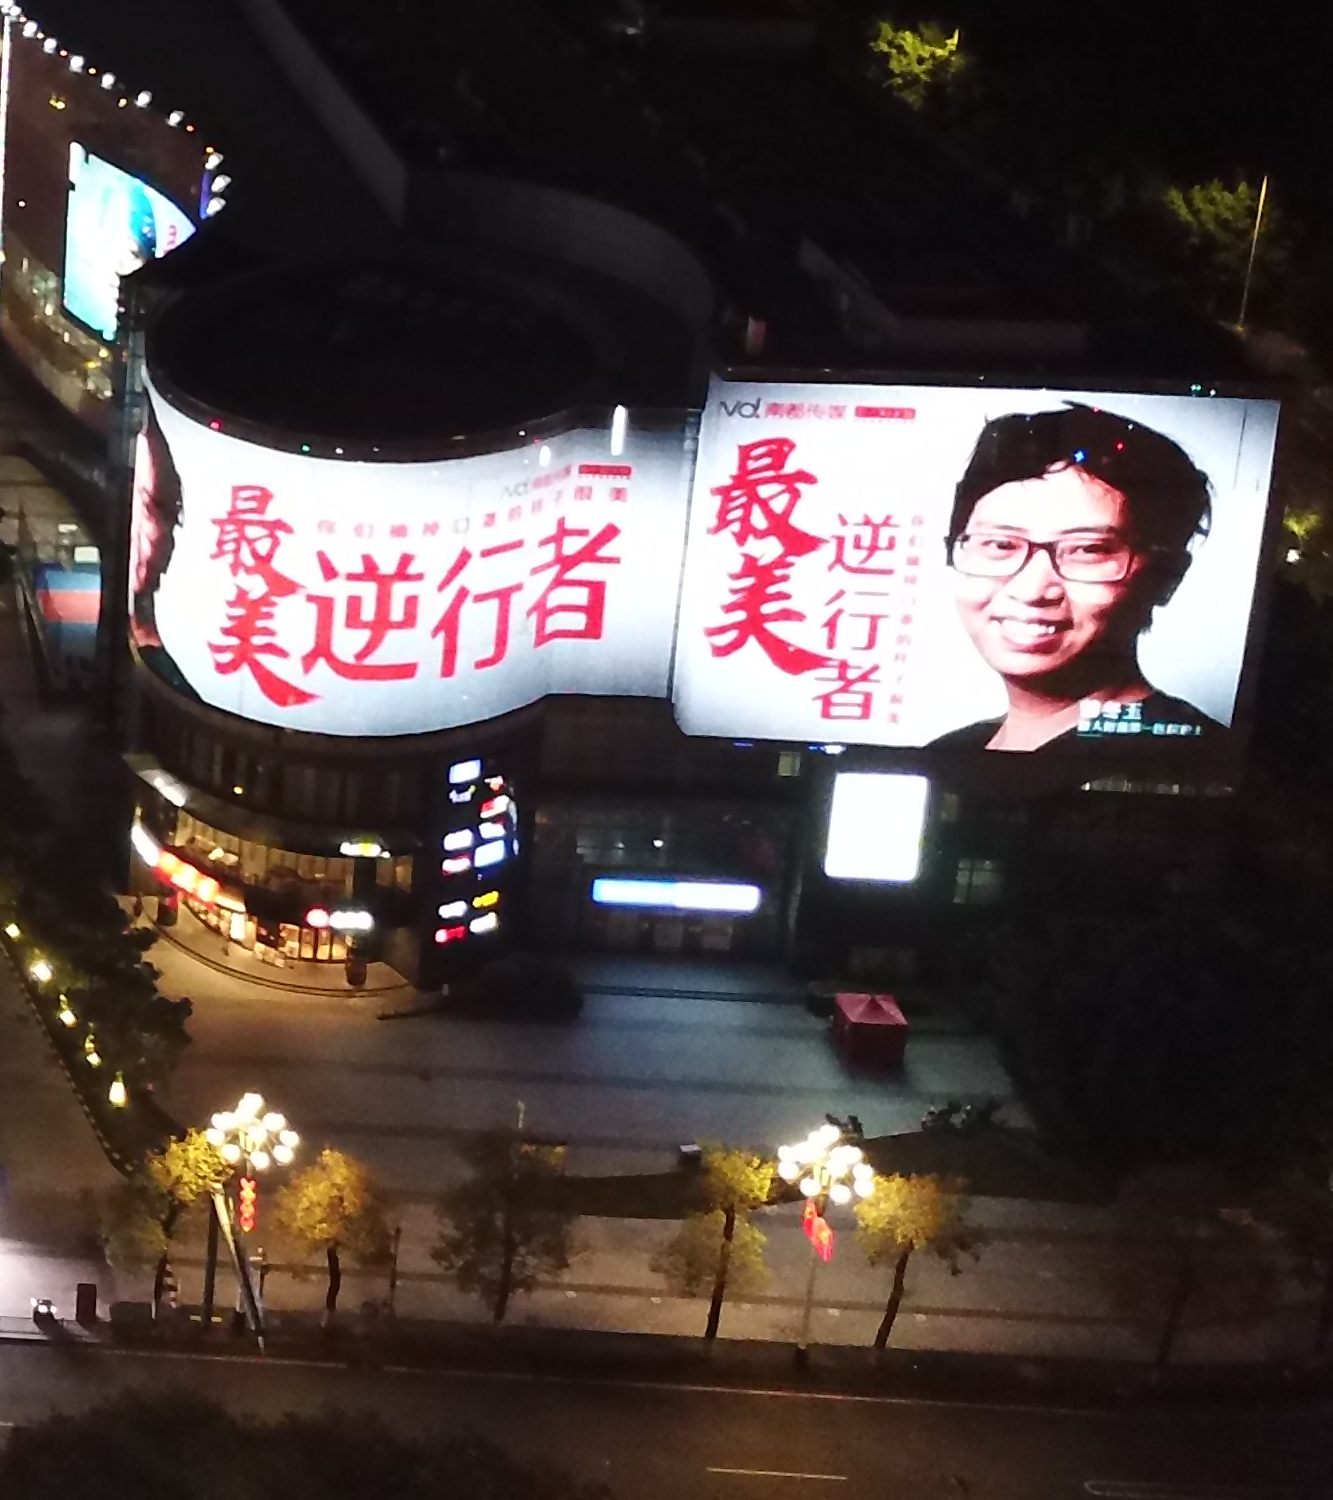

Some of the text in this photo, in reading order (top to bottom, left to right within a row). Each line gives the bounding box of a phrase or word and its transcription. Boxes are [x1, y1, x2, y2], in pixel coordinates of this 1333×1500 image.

[208, 485, 322, 707] 最美
[301, 516, 622, 681] 逆行者
[703, 437, 841, 675] 最美
[812, 513, 900, 720] 逆行者
